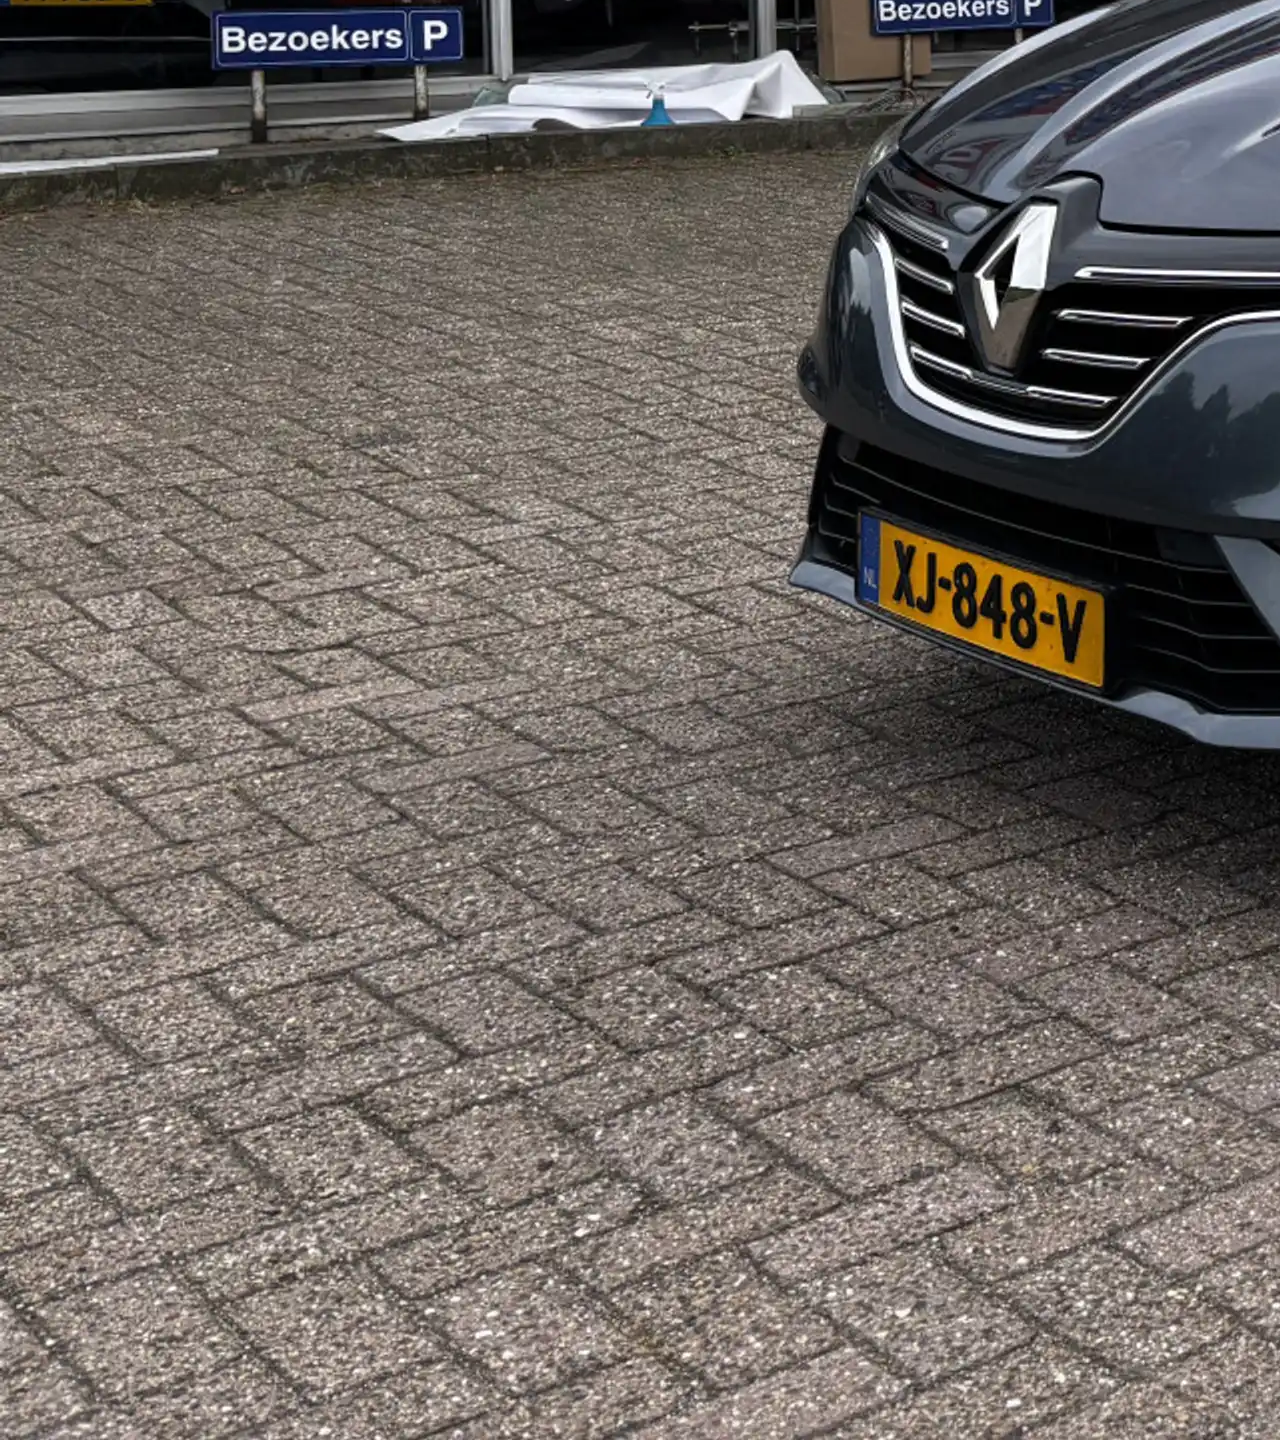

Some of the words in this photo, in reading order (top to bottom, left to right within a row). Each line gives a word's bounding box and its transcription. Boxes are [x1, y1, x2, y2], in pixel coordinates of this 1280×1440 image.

[221, 25, 403, 53] Bezoekers
[423, 20, 448, 50] P
[893, 539, 1087, 663] XJ-848-V
